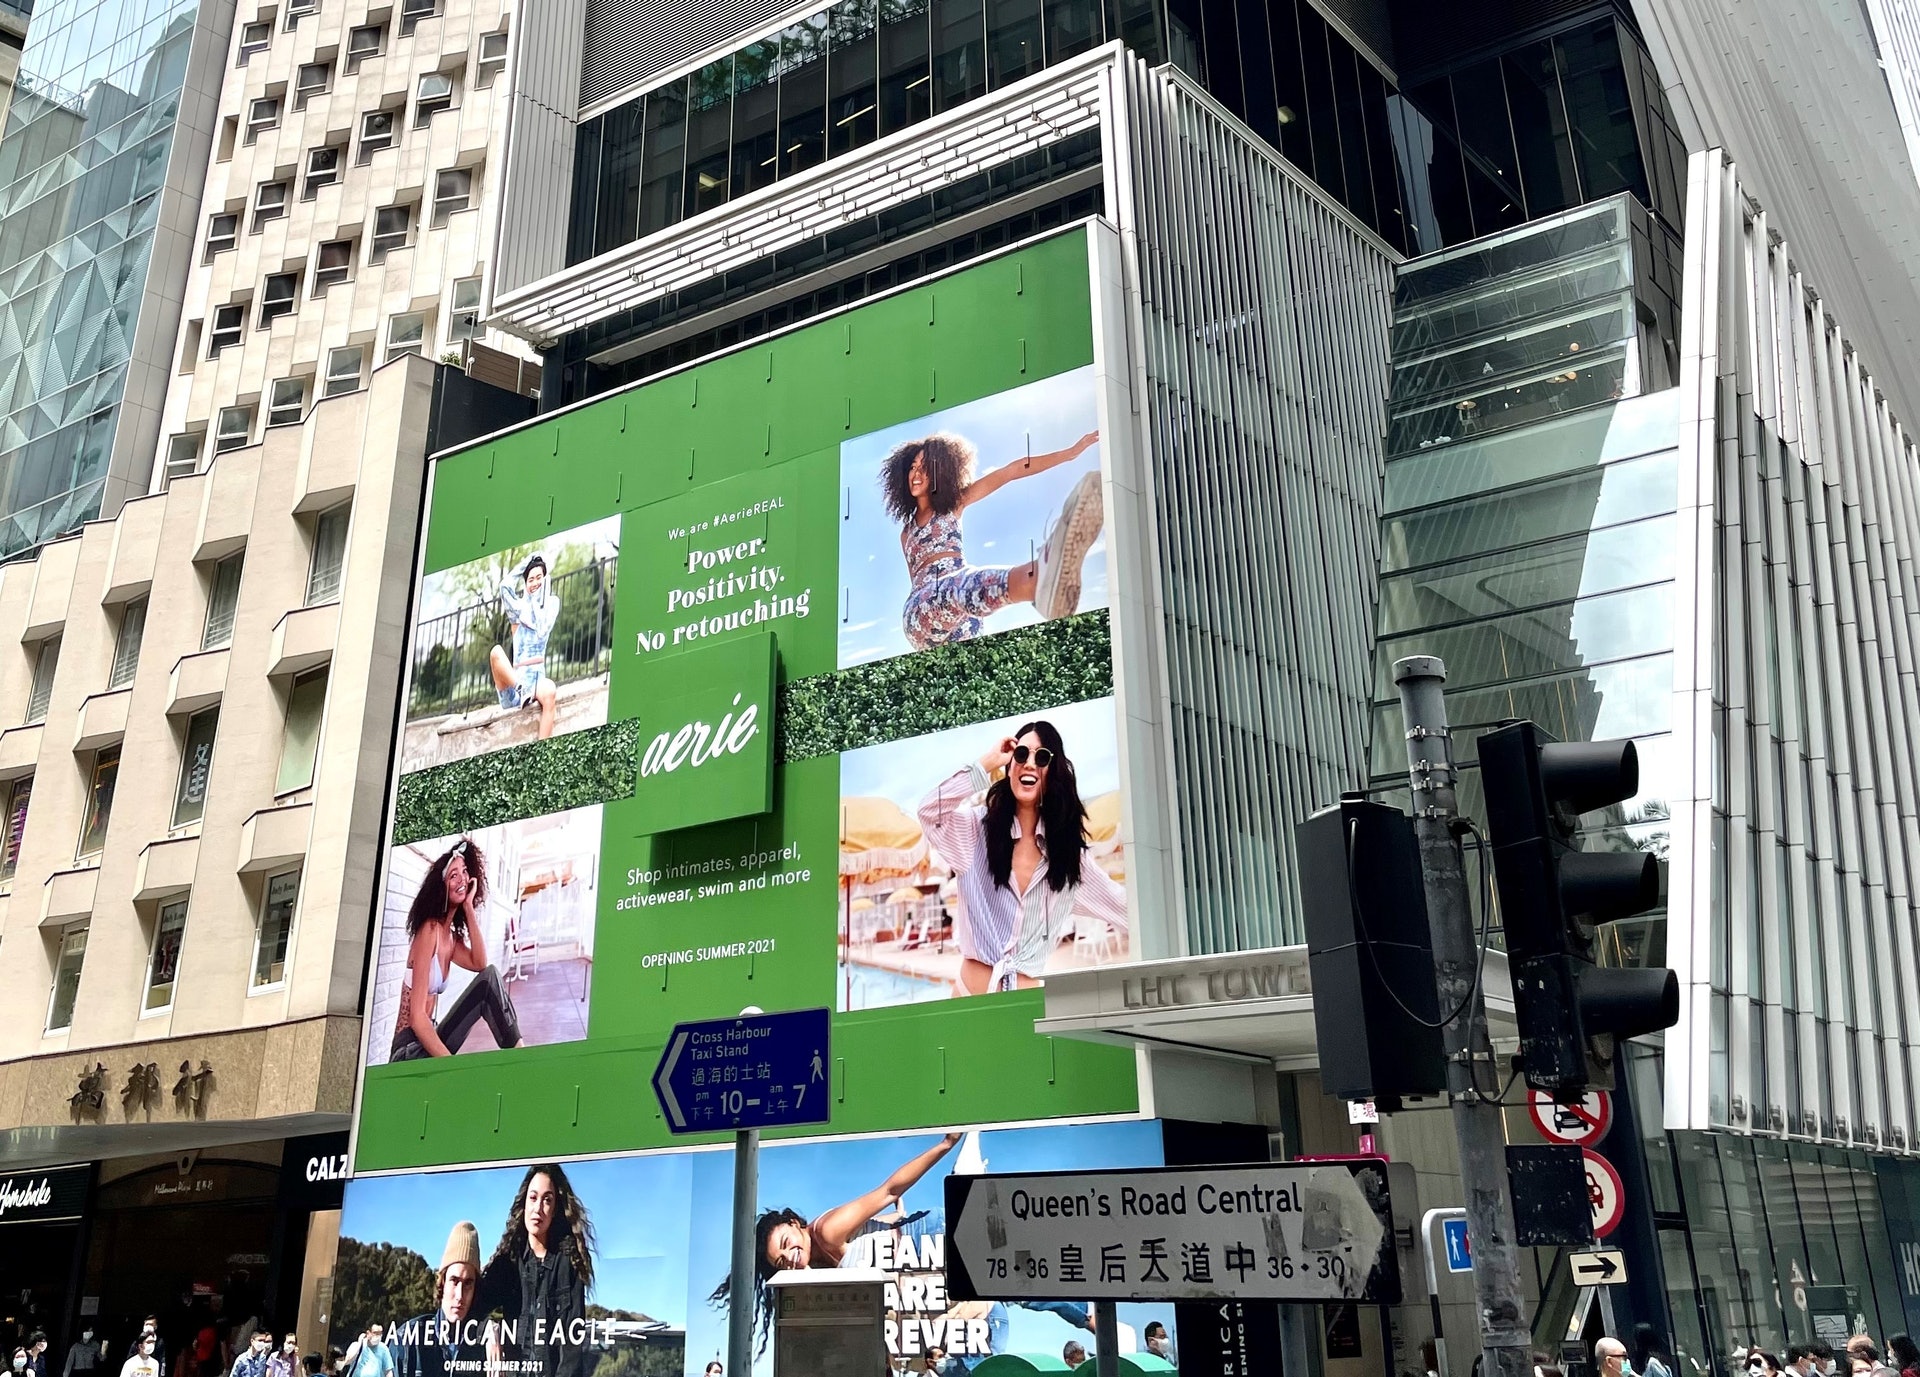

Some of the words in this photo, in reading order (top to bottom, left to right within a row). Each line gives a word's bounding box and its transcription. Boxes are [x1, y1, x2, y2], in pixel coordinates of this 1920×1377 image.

[668, 528, 686, 541] We
[690, 523, 709, 535] are
[713, 497, 784, 526] #AerieREAL
[687, 537, 766, 574] Power.
[666, 565, 785, 613] Positivity.
[635, 629, 666, 655] No
[672, 588, 811, 645] retouching
[626, 868, 662, 886] Shop
[666, 857, 735, 880] intimates,
[740, 841, 801, 871] apparel,
[616, 888, 693, 911] activewear,
[698, 882, 733, 898] swim
[738, 875, 766, 892] and
[771, 868, 811, 886] more
[641, 950, 693, 969] OPENING
[696, 943, 746, 961] SUMMER
[748, 938, 776, 954] 2021
[1122, 973, 1185, 1008] LHT
[691, 1032, 723, 1045] Cross
[726, 1027, 771, 1041] Harbour
[691, 1047, 713, 1060] Taxi
[716, 1044, 749, 1058] Stand
[691, 1062, 771, 1086] 過海的士站
[691, 1106, 714, 1120] 下午
[720, 1090, 743, 1115] 10
[764, 1099, 788, 1115] 上午
[793, 1084, 806, 1109] 7
[695, 1092, 710, 1102] pm
[769, 1085, 783, 1093] am
[306, 1154, 349, 1182] CALZ
[0, 1178, 51, 1215] Homebake
[1011, 1188, 1111, 1221] Queen's
[1121, 1185, 1187, 1216] Road
[1197, 1181, 1303, 1214] Central
[986, 1258, 1008, 1278] 78
[1026, 1257, 1049, 1279] 36
[1267, 1256, 1294, 1279] 36
[1317, 1255, 1346, 1279] 30
[884, 1276, 946, 1311] ARE
[384, 1318, 518, 1346] AMERICAN
[534, 1317, 617, 1345] EAGLE
[443, 1360, 482, 1372] OPENING
[483, 1360, 520, 1372] SUMMER
[521, 1360, 543, 1372] 2021
